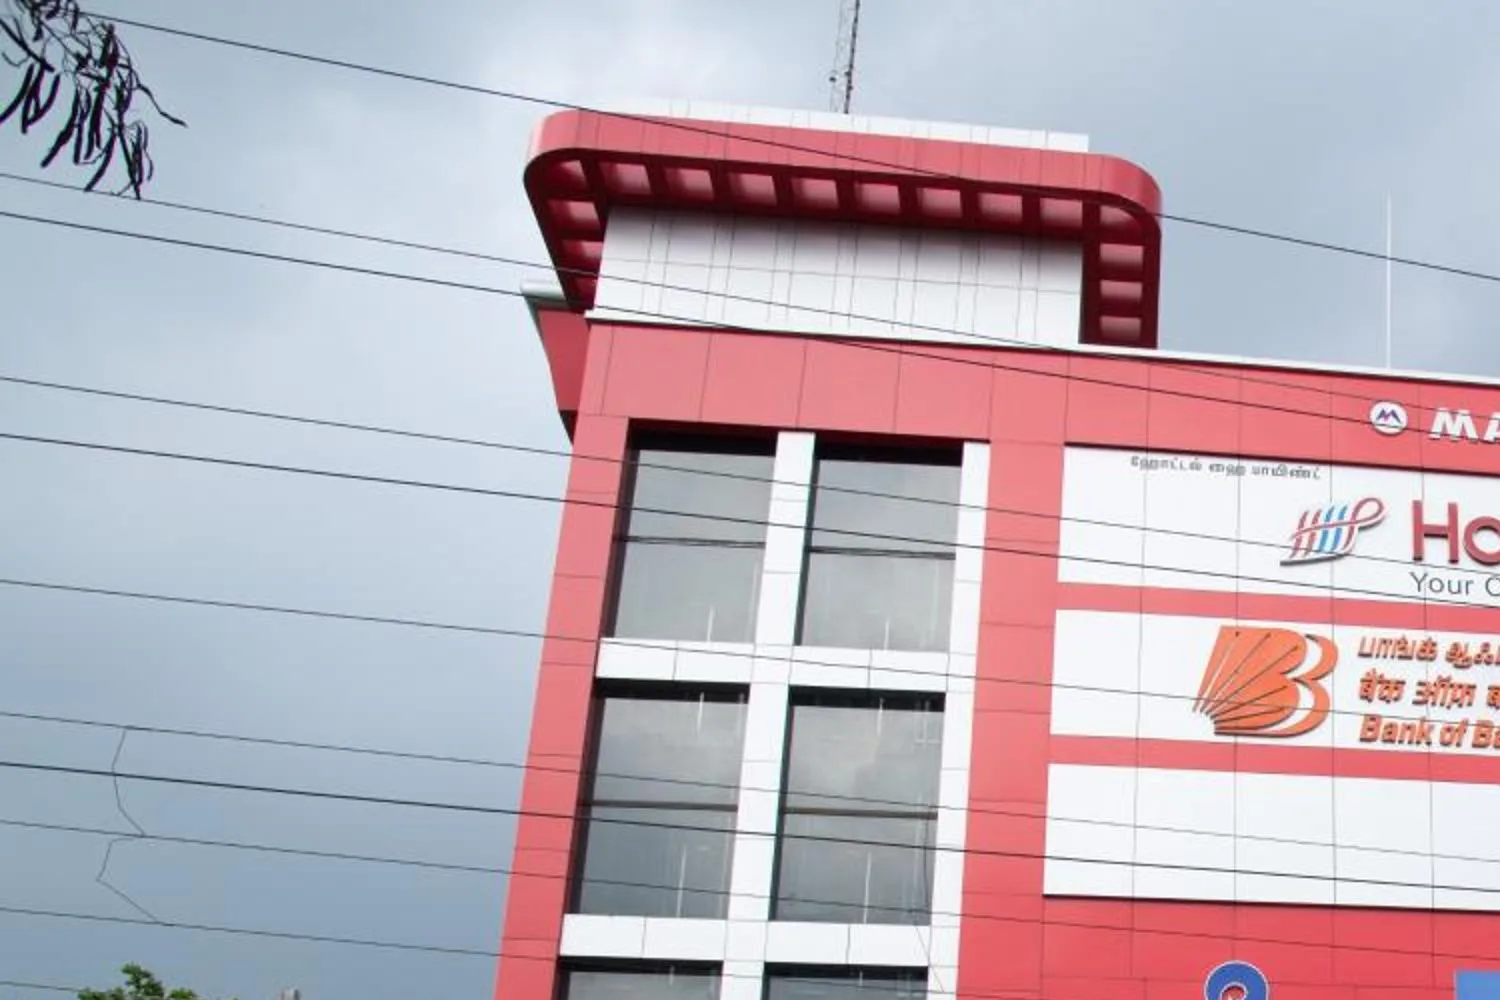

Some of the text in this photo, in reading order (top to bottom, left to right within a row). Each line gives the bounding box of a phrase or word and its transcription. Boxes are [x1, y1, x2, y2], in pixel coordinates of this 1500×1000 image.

[1409, 571, 1475, 597] Your
[1359, 713, 1434, 746] Bank
[1439, 719, 1469, 747] of
